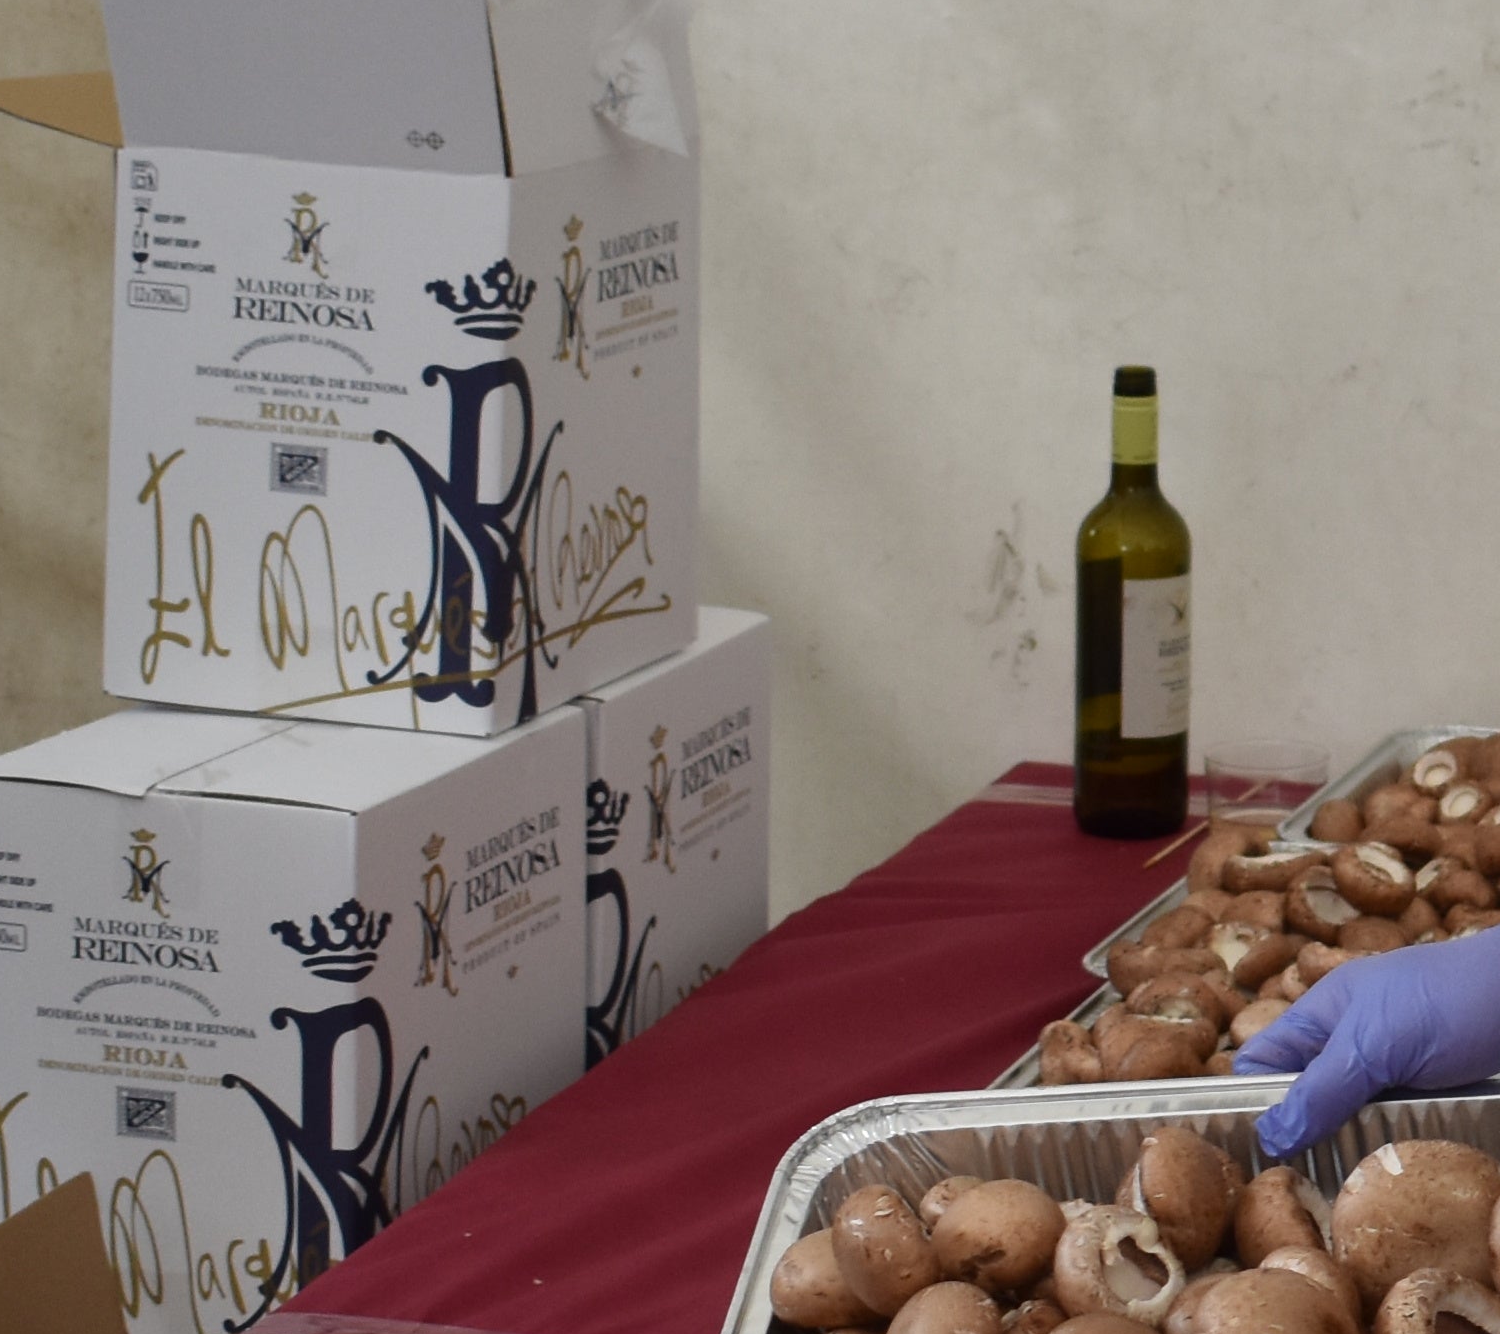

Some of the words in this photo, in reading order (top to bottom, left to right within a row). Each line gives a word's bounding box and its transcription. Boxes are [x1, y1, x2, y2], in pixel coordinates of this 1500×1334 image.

[236, 276, 342, 300] MARQUÉS
[346, 287, 376, 304] DE
[597, 250, 680, 303] REINOSA
[233, 296, 376, 332] REINOSA
[196, 364, 259, 381] BODEGAS
[260, 371, 325, 387] MARQUÉS
[328, 378, 348, 390] DE
[350, 380, 409, 396] REINOSA
[259, 401, 341, 427] RIOJA
[466, 819, 538, 872] MARQUÉS
[539, 805, 561, 834] DE
[465, 838, 562, 915] REINOSA
[73, 916, 183, 940] MARQUÉS
[188, 927, 219, 945] DE
[72, 935, 221, 973] REINOSA
[37, 1005, 100, 1022] BODEGAS
[103, 1012, 171, 1030] MARQUÉS
[173, 1020, 193, 1033] DE
[196, 1021, 257, 1040] REINOSA
[102, 1044, 188, 1070] RIOJA
